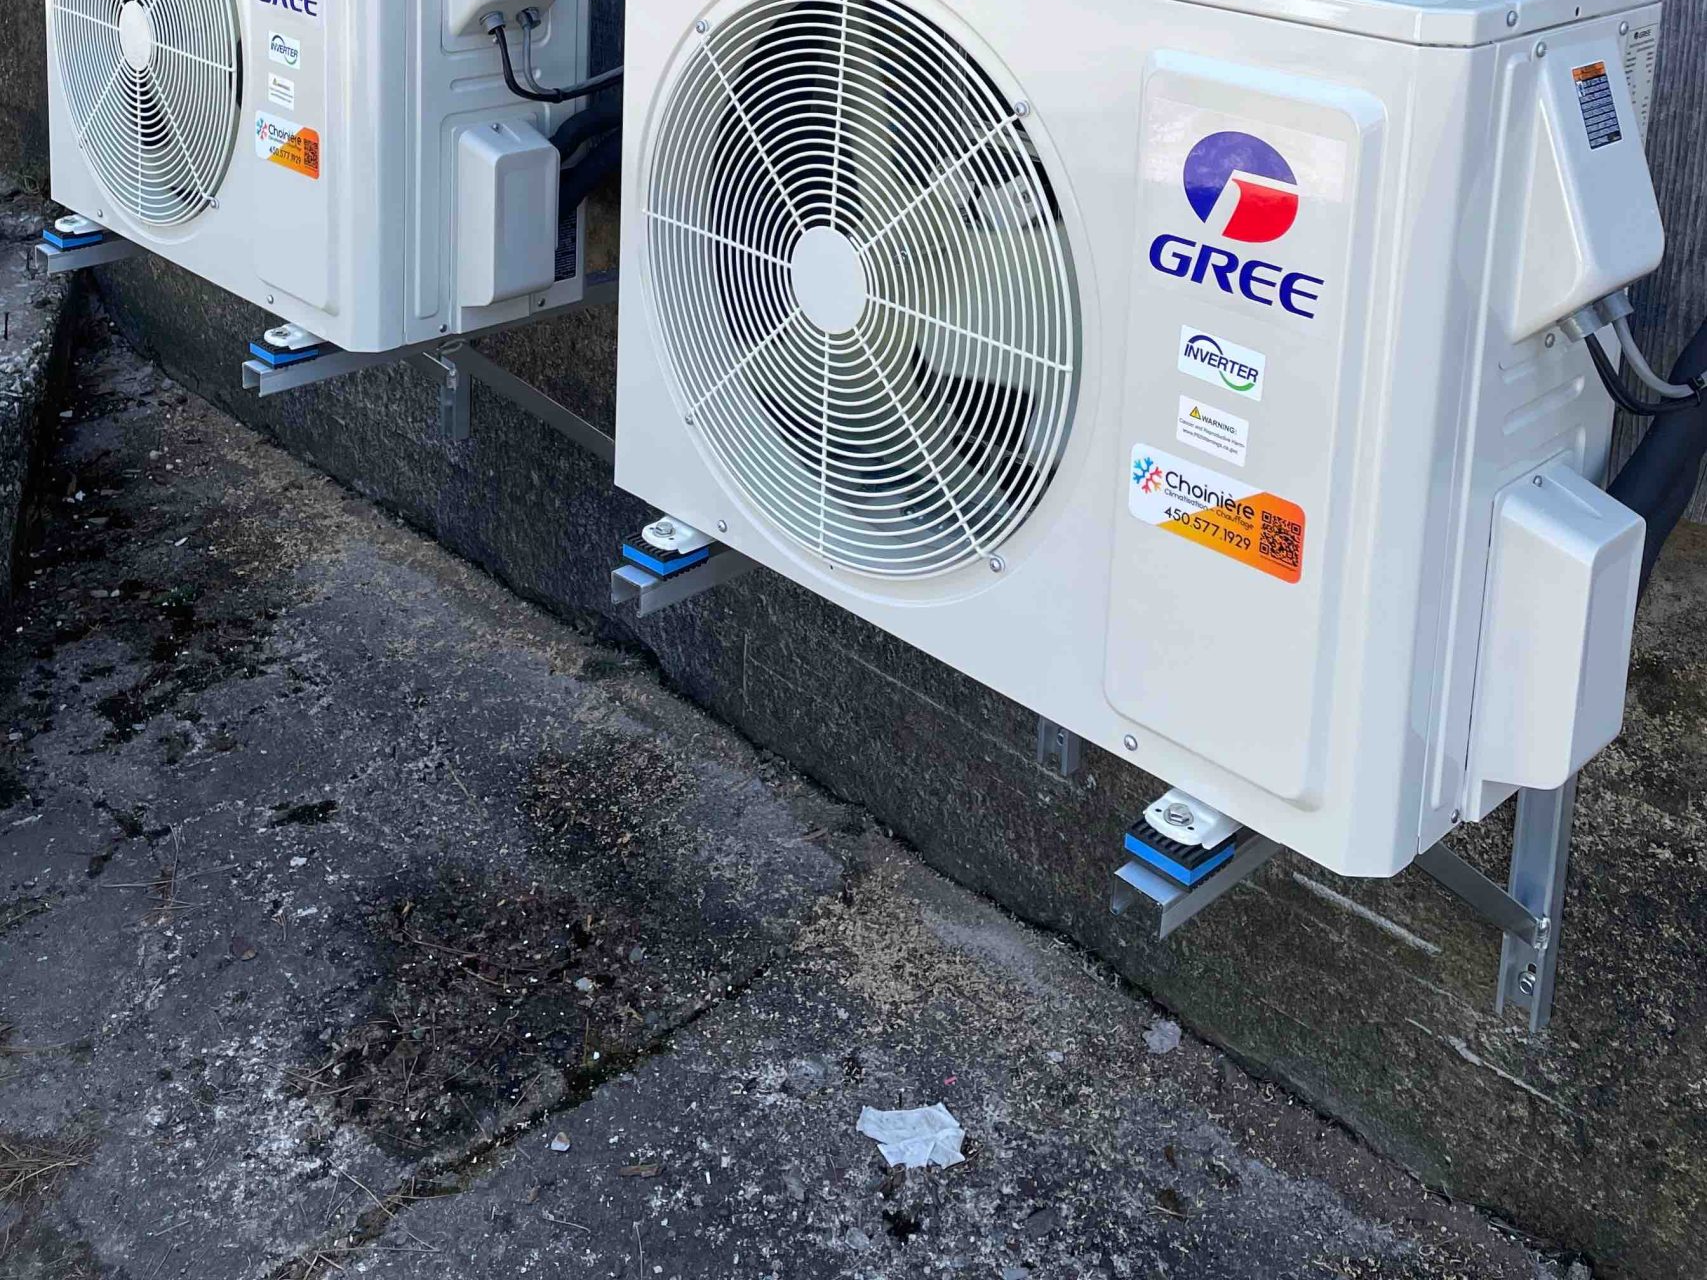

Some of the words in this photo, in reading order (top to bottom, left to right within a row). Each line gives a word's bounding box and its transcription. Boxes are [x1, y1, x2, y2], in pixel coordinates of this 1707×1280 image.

[271, 43, 298, 58] INVERTER
[1149, 233, 1325, 319] GREE
[1184, 343, 1259, 383] INVERTER
[1164, 488, 1209, 511] Climatisation
[1215, 509, 1254, 530] Chauffage
[1165, 471, 1255, 520] Choinière
[1164, 507, 1251, 550] 450.577.1929
